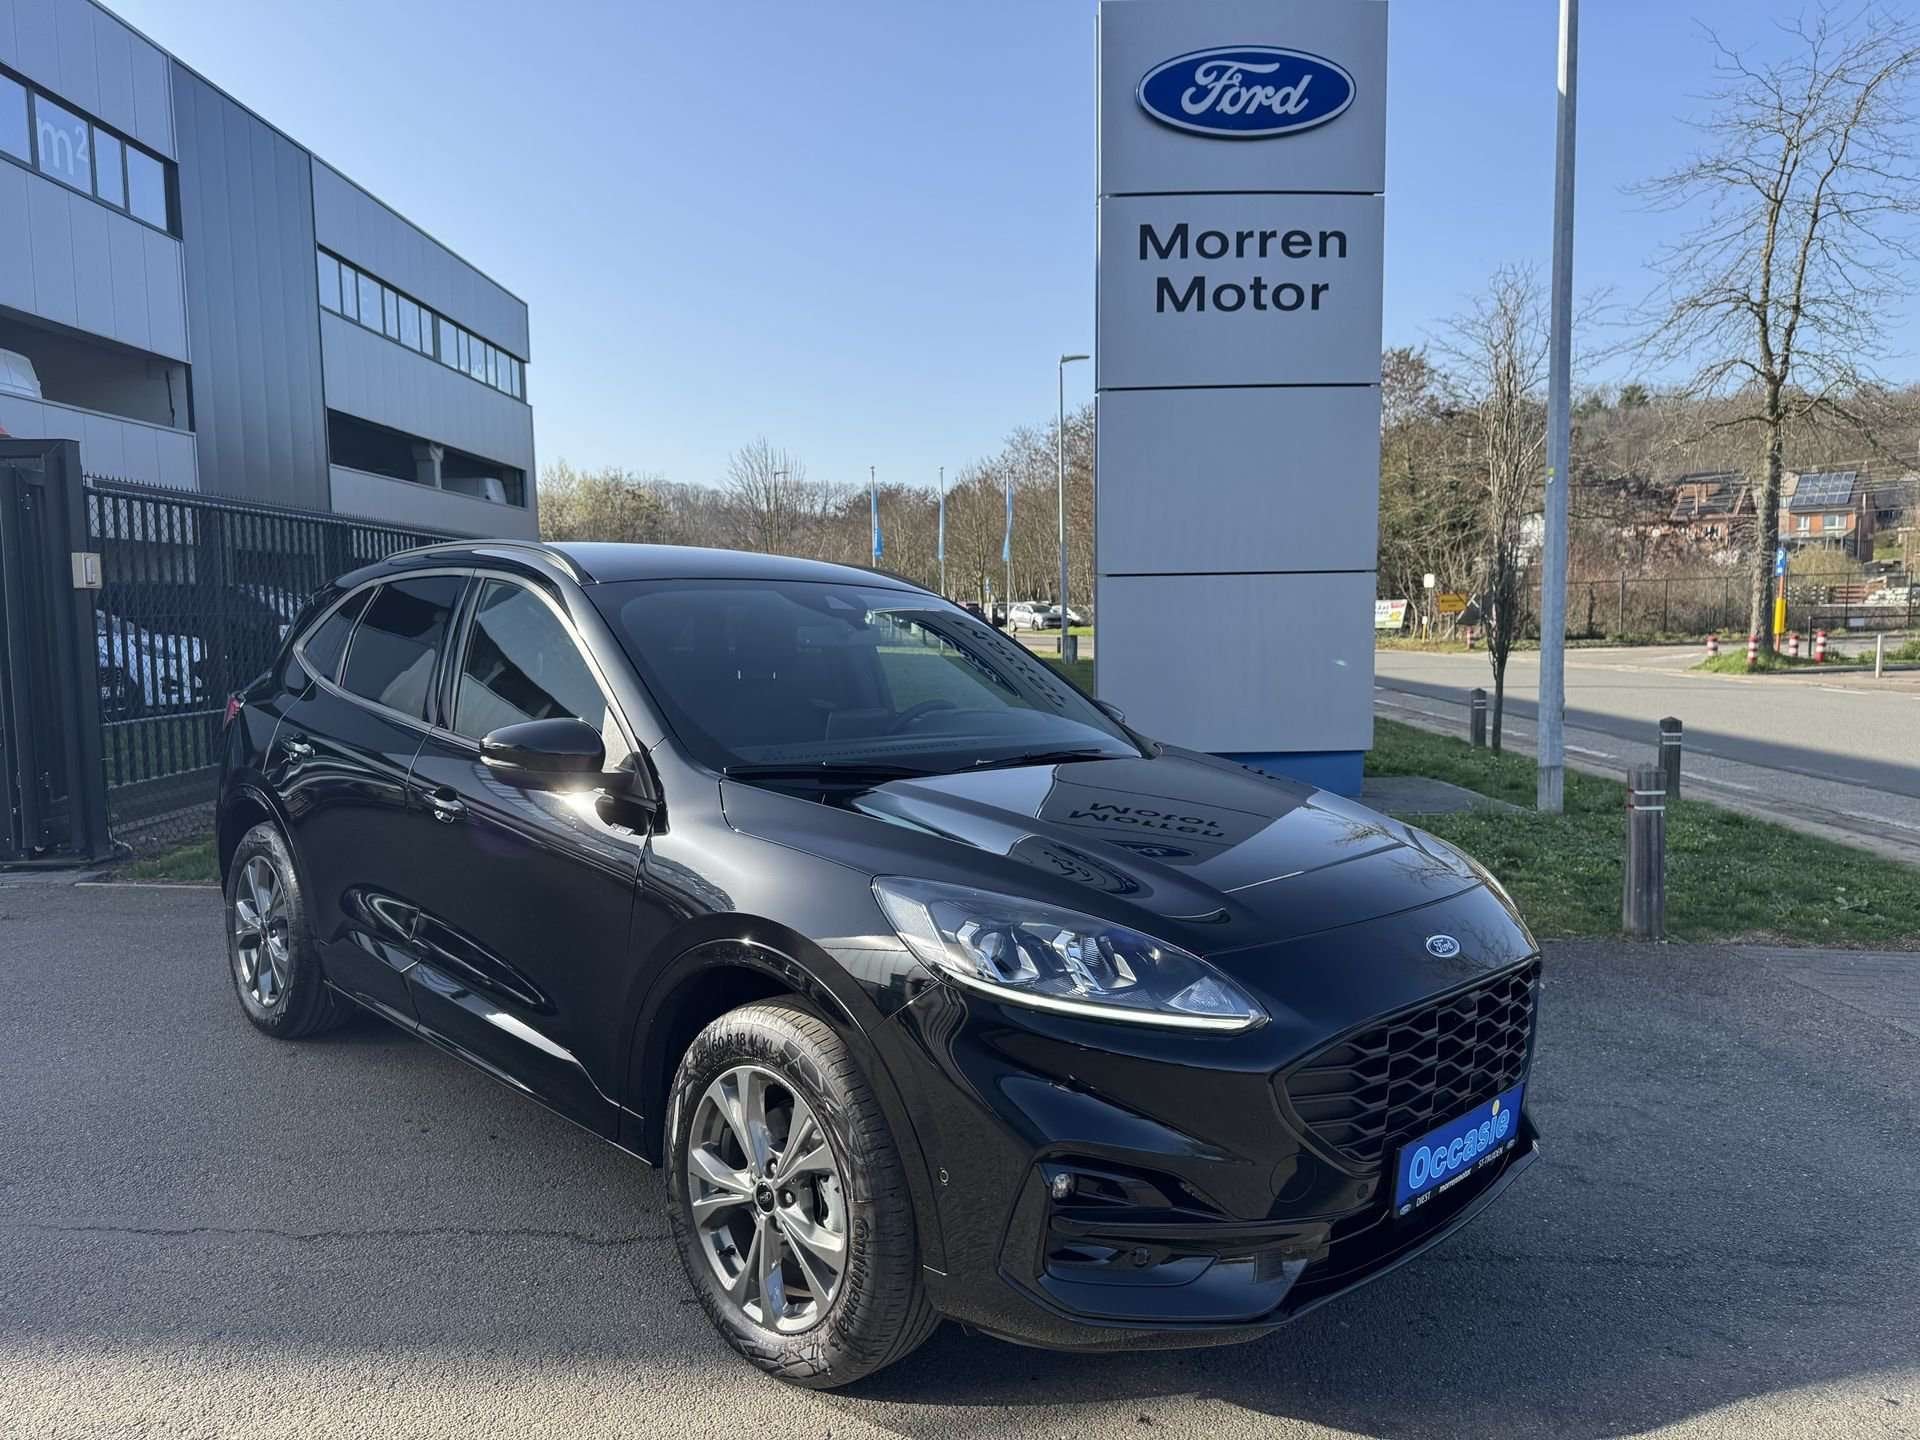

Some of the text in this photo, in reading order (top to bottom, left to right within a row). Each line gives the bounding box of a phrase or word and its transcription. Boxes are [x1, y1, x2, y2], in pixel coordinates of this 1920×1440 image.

[1181, 60, 1313, 116] Ford
[1139, 223, 1347, 260] Morren
[1156, 276, 1329, 313] Motor
[1431, 939, 1454, 953] Ford
[1408, 1099, 1511, 1190] Occasie
